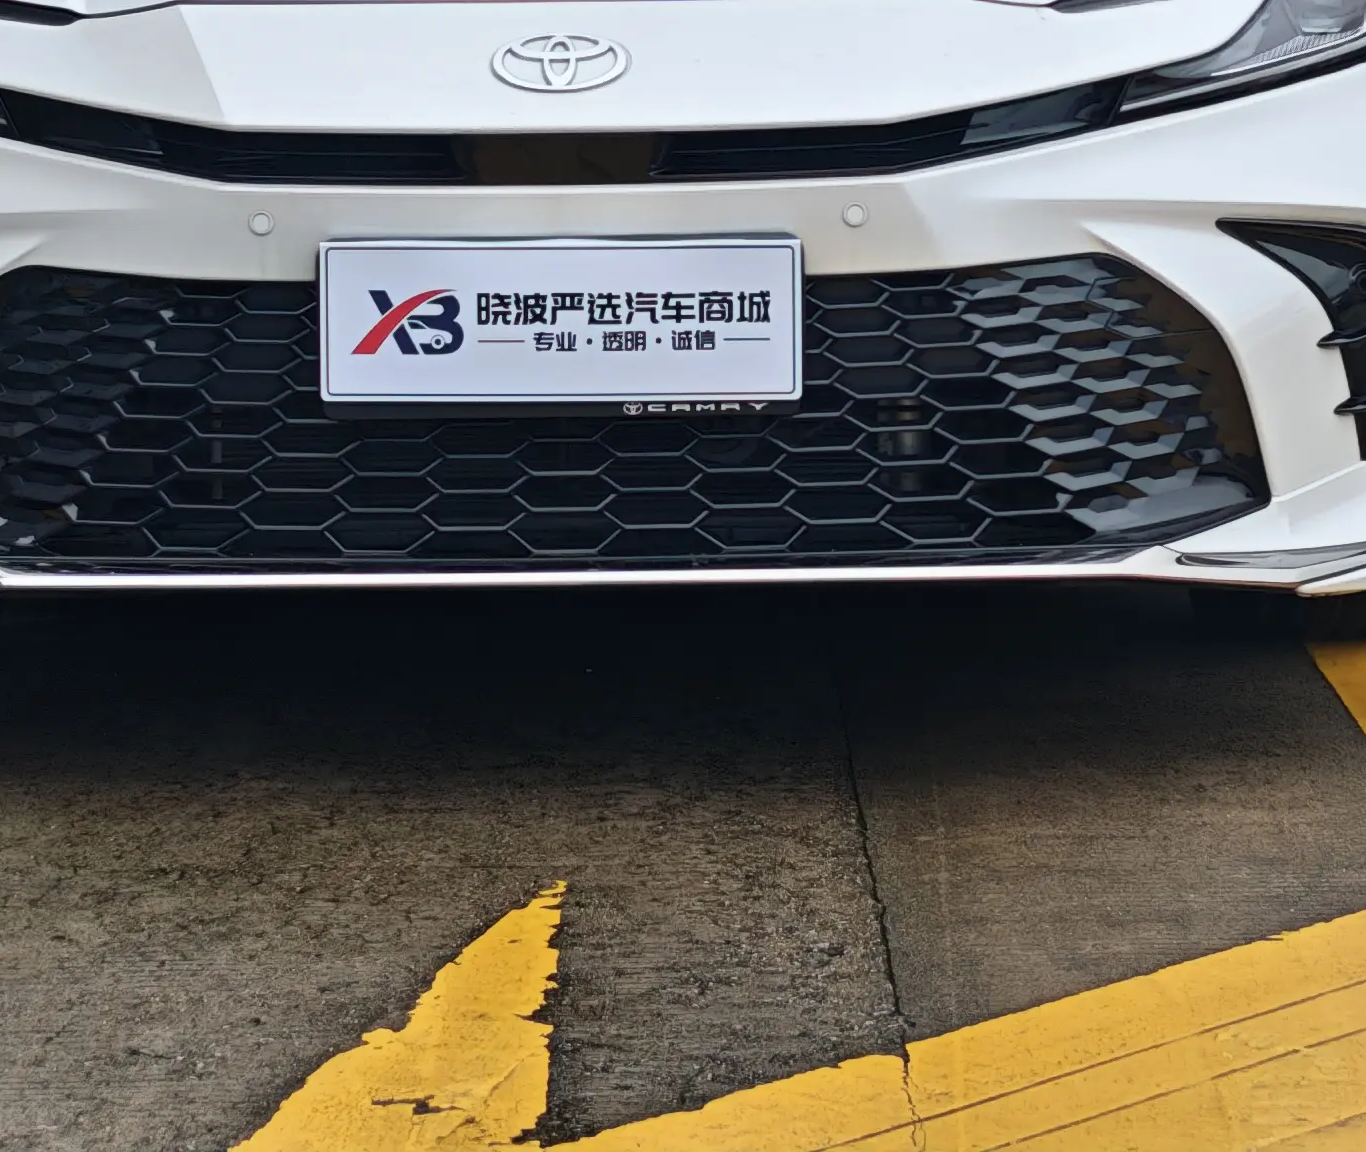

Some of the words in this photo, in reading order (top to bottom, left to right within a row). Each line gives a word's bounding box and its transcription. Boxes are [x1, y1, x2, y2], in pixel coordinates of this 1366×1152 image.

[476, 290, 771, 325] 晓波严选汽车商城
[647, 402, 768, 412] CAMRY
